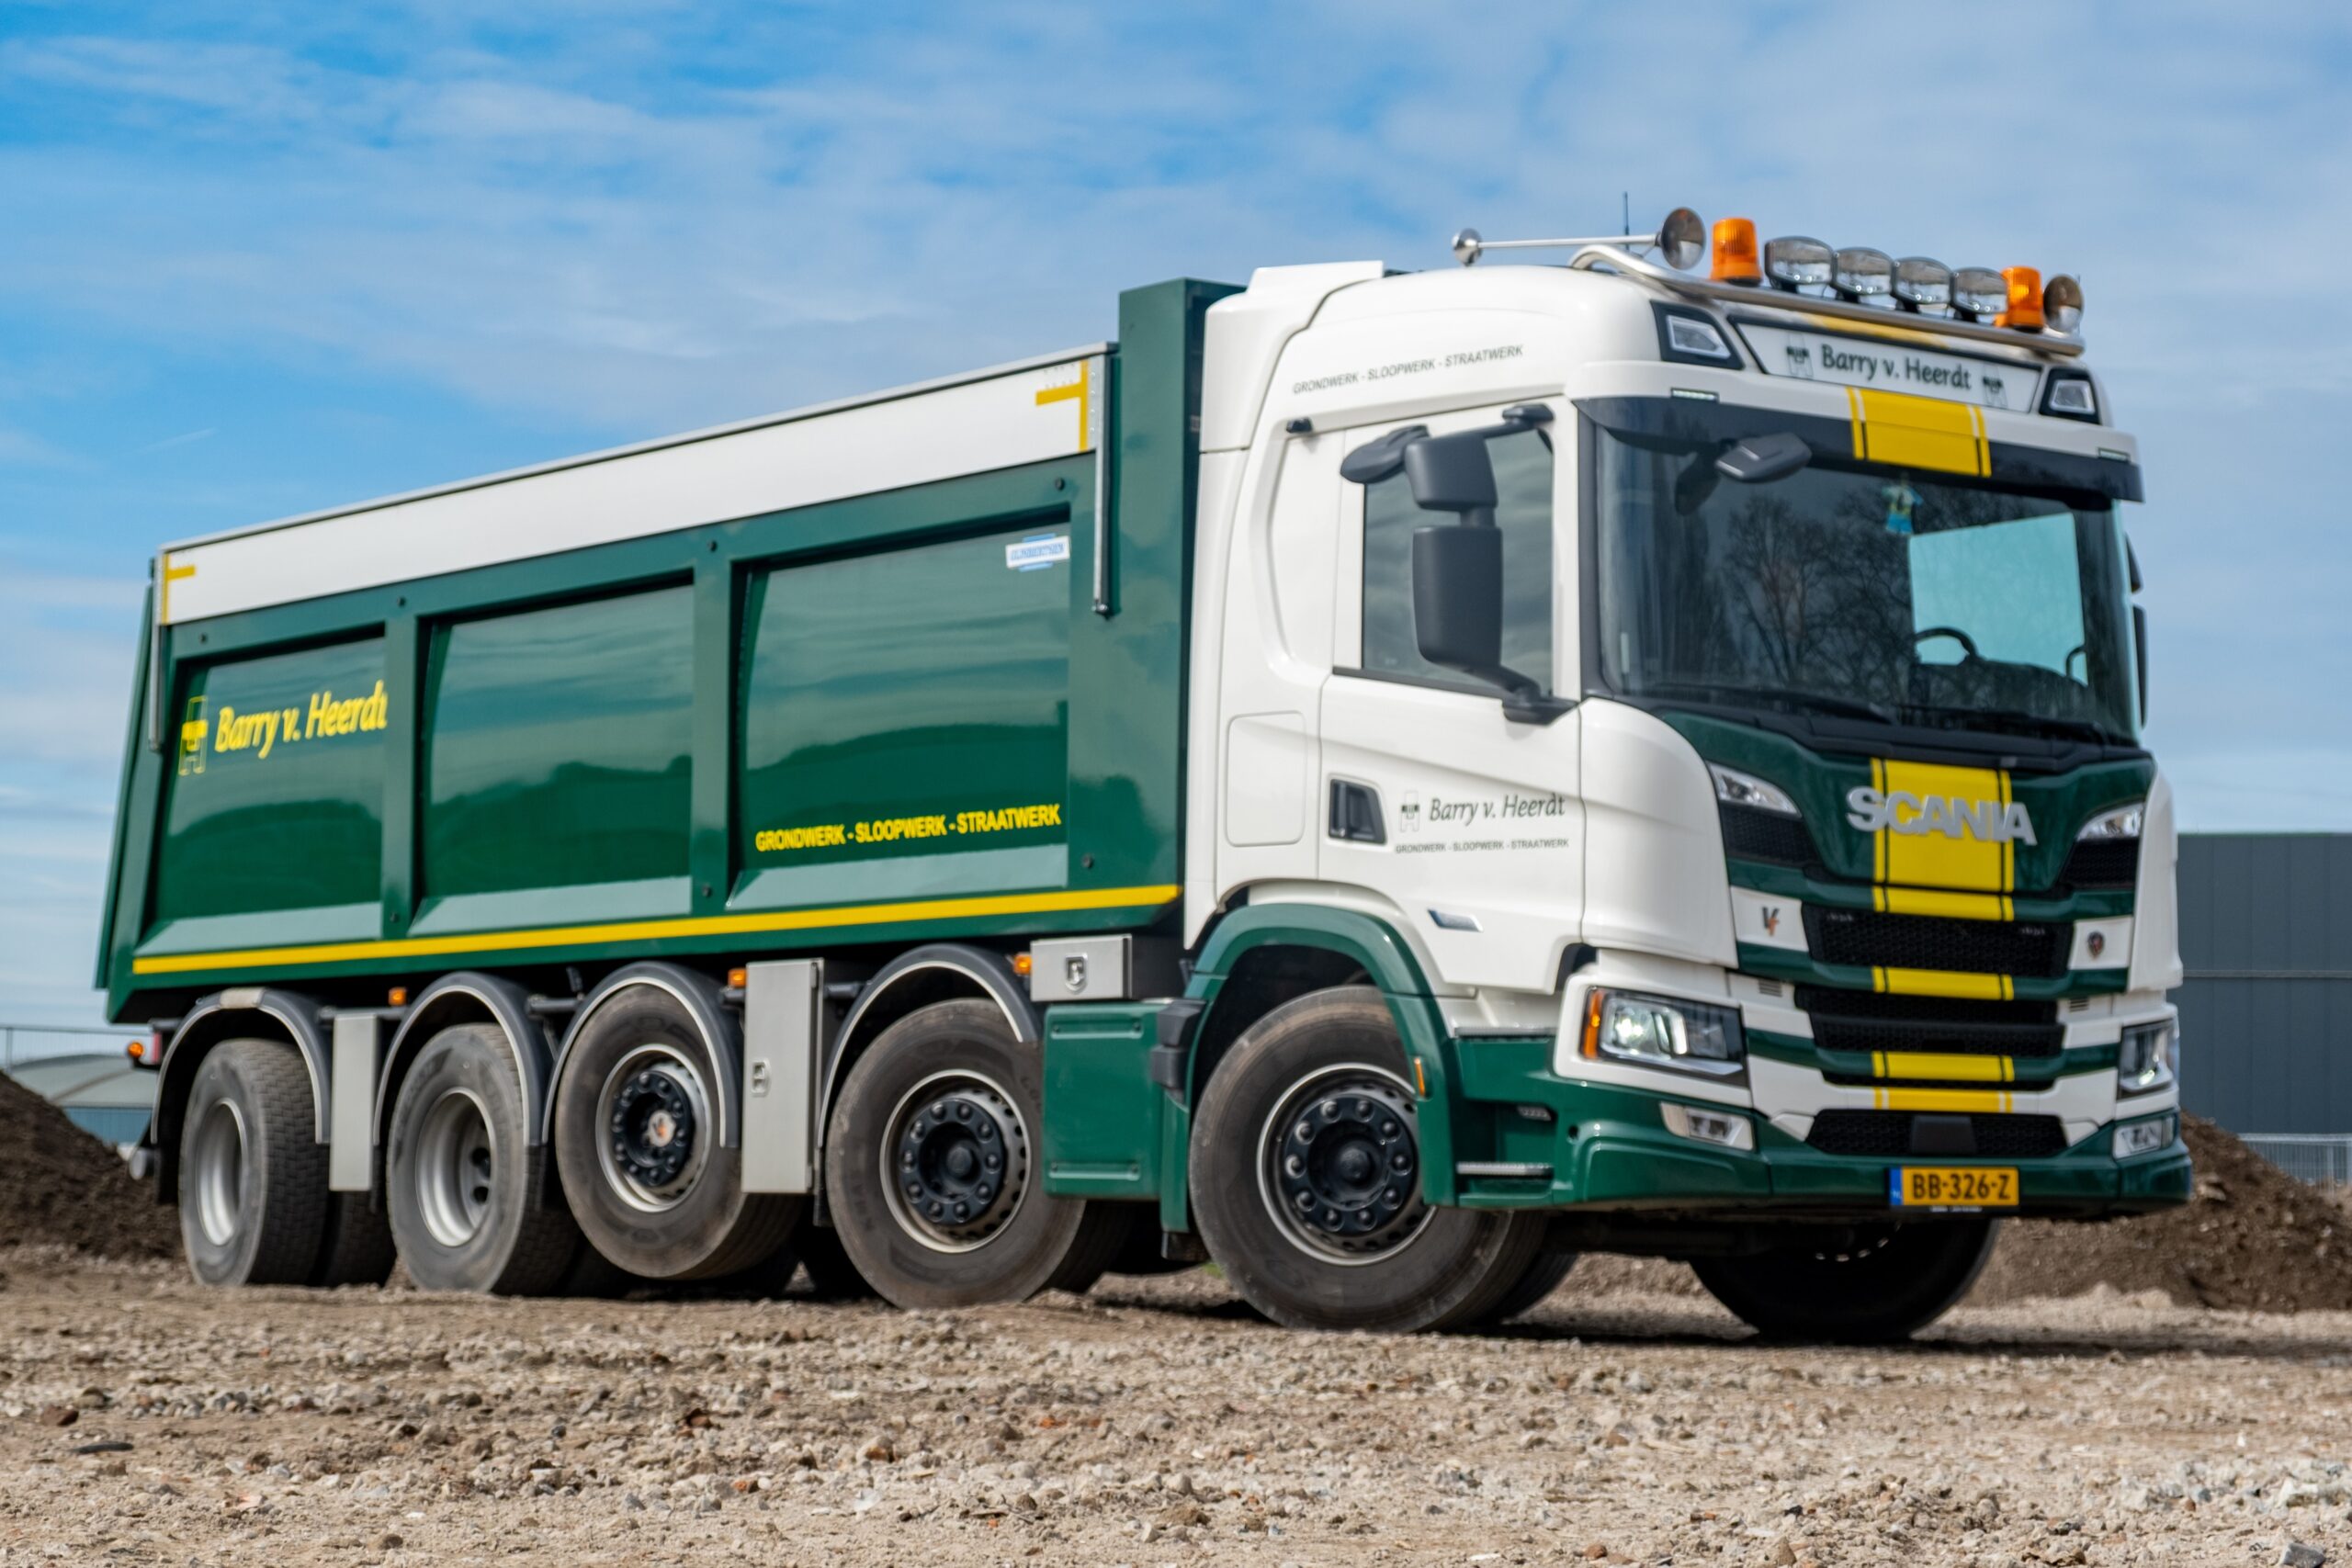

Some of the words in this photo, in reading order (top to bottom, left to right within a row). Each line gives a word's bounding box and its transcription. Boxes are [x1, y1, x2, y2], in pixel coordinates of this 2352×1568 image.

[1294, 372, 1359, 395] GRONDWERK
[1367, 359, 1435, 381] SLOOPWERK
[1445, 344, 1523, 367] STRAATWERK
[1821, 343, 1878, 380] Barry
[1883, 357, 1899, 379] v.
[1905, 356, 1972, 390] Heerdt
[215, 706, 280, 759] Barry
[282, 706, 301, 742] v.
[305, 679, 388, 739] Heerdt
[755, 824, 847, 852] GRONDWERK
[854, 815, 947, 844] SLOOPWERK
[956, 804, 1062, 834] STRAATWERK
[1429, 797, 1479, 827] Barry
[1483, 801, 1497, 819] v.
[1501, 792, 1566, 818] Heerdt
[1846, 785, 2038, 846] SCANIA
[1395, 842, 1447, 854] GRONDWERK
[1453, 840, 1504, 852] SLOOPWERK
[1510, 838, 1569, 851] STRAATWERK
[1912, 1173, 2011, 1201] BB-326-Z
